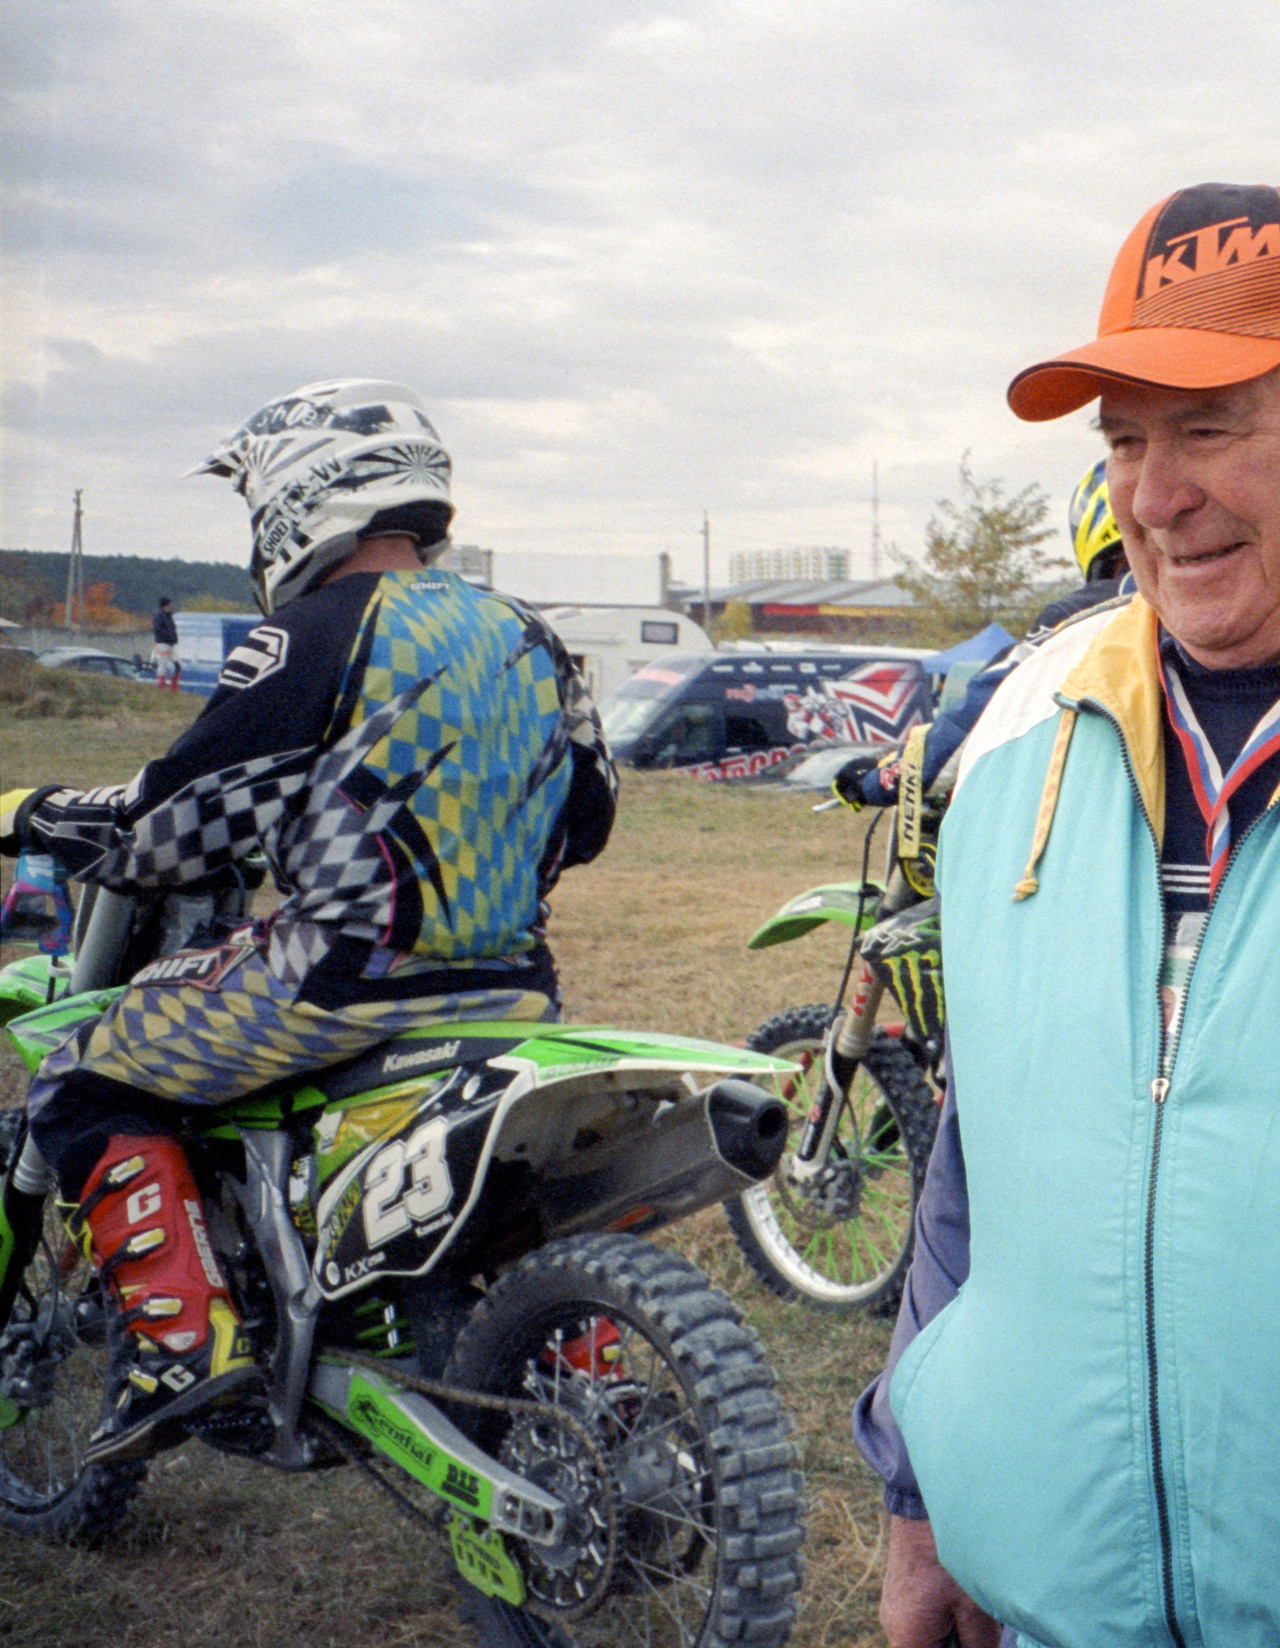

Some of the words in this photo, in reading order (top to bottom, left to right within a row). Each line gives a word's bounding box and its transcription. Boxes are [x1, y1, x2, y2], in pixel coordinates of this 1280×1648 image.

[262, 520, 289, 556] SHOEI
[363, 1115, 454, 1250] 23
[127, 1182, 162, 1225] G
[160, 1363, 196, 1392] G
